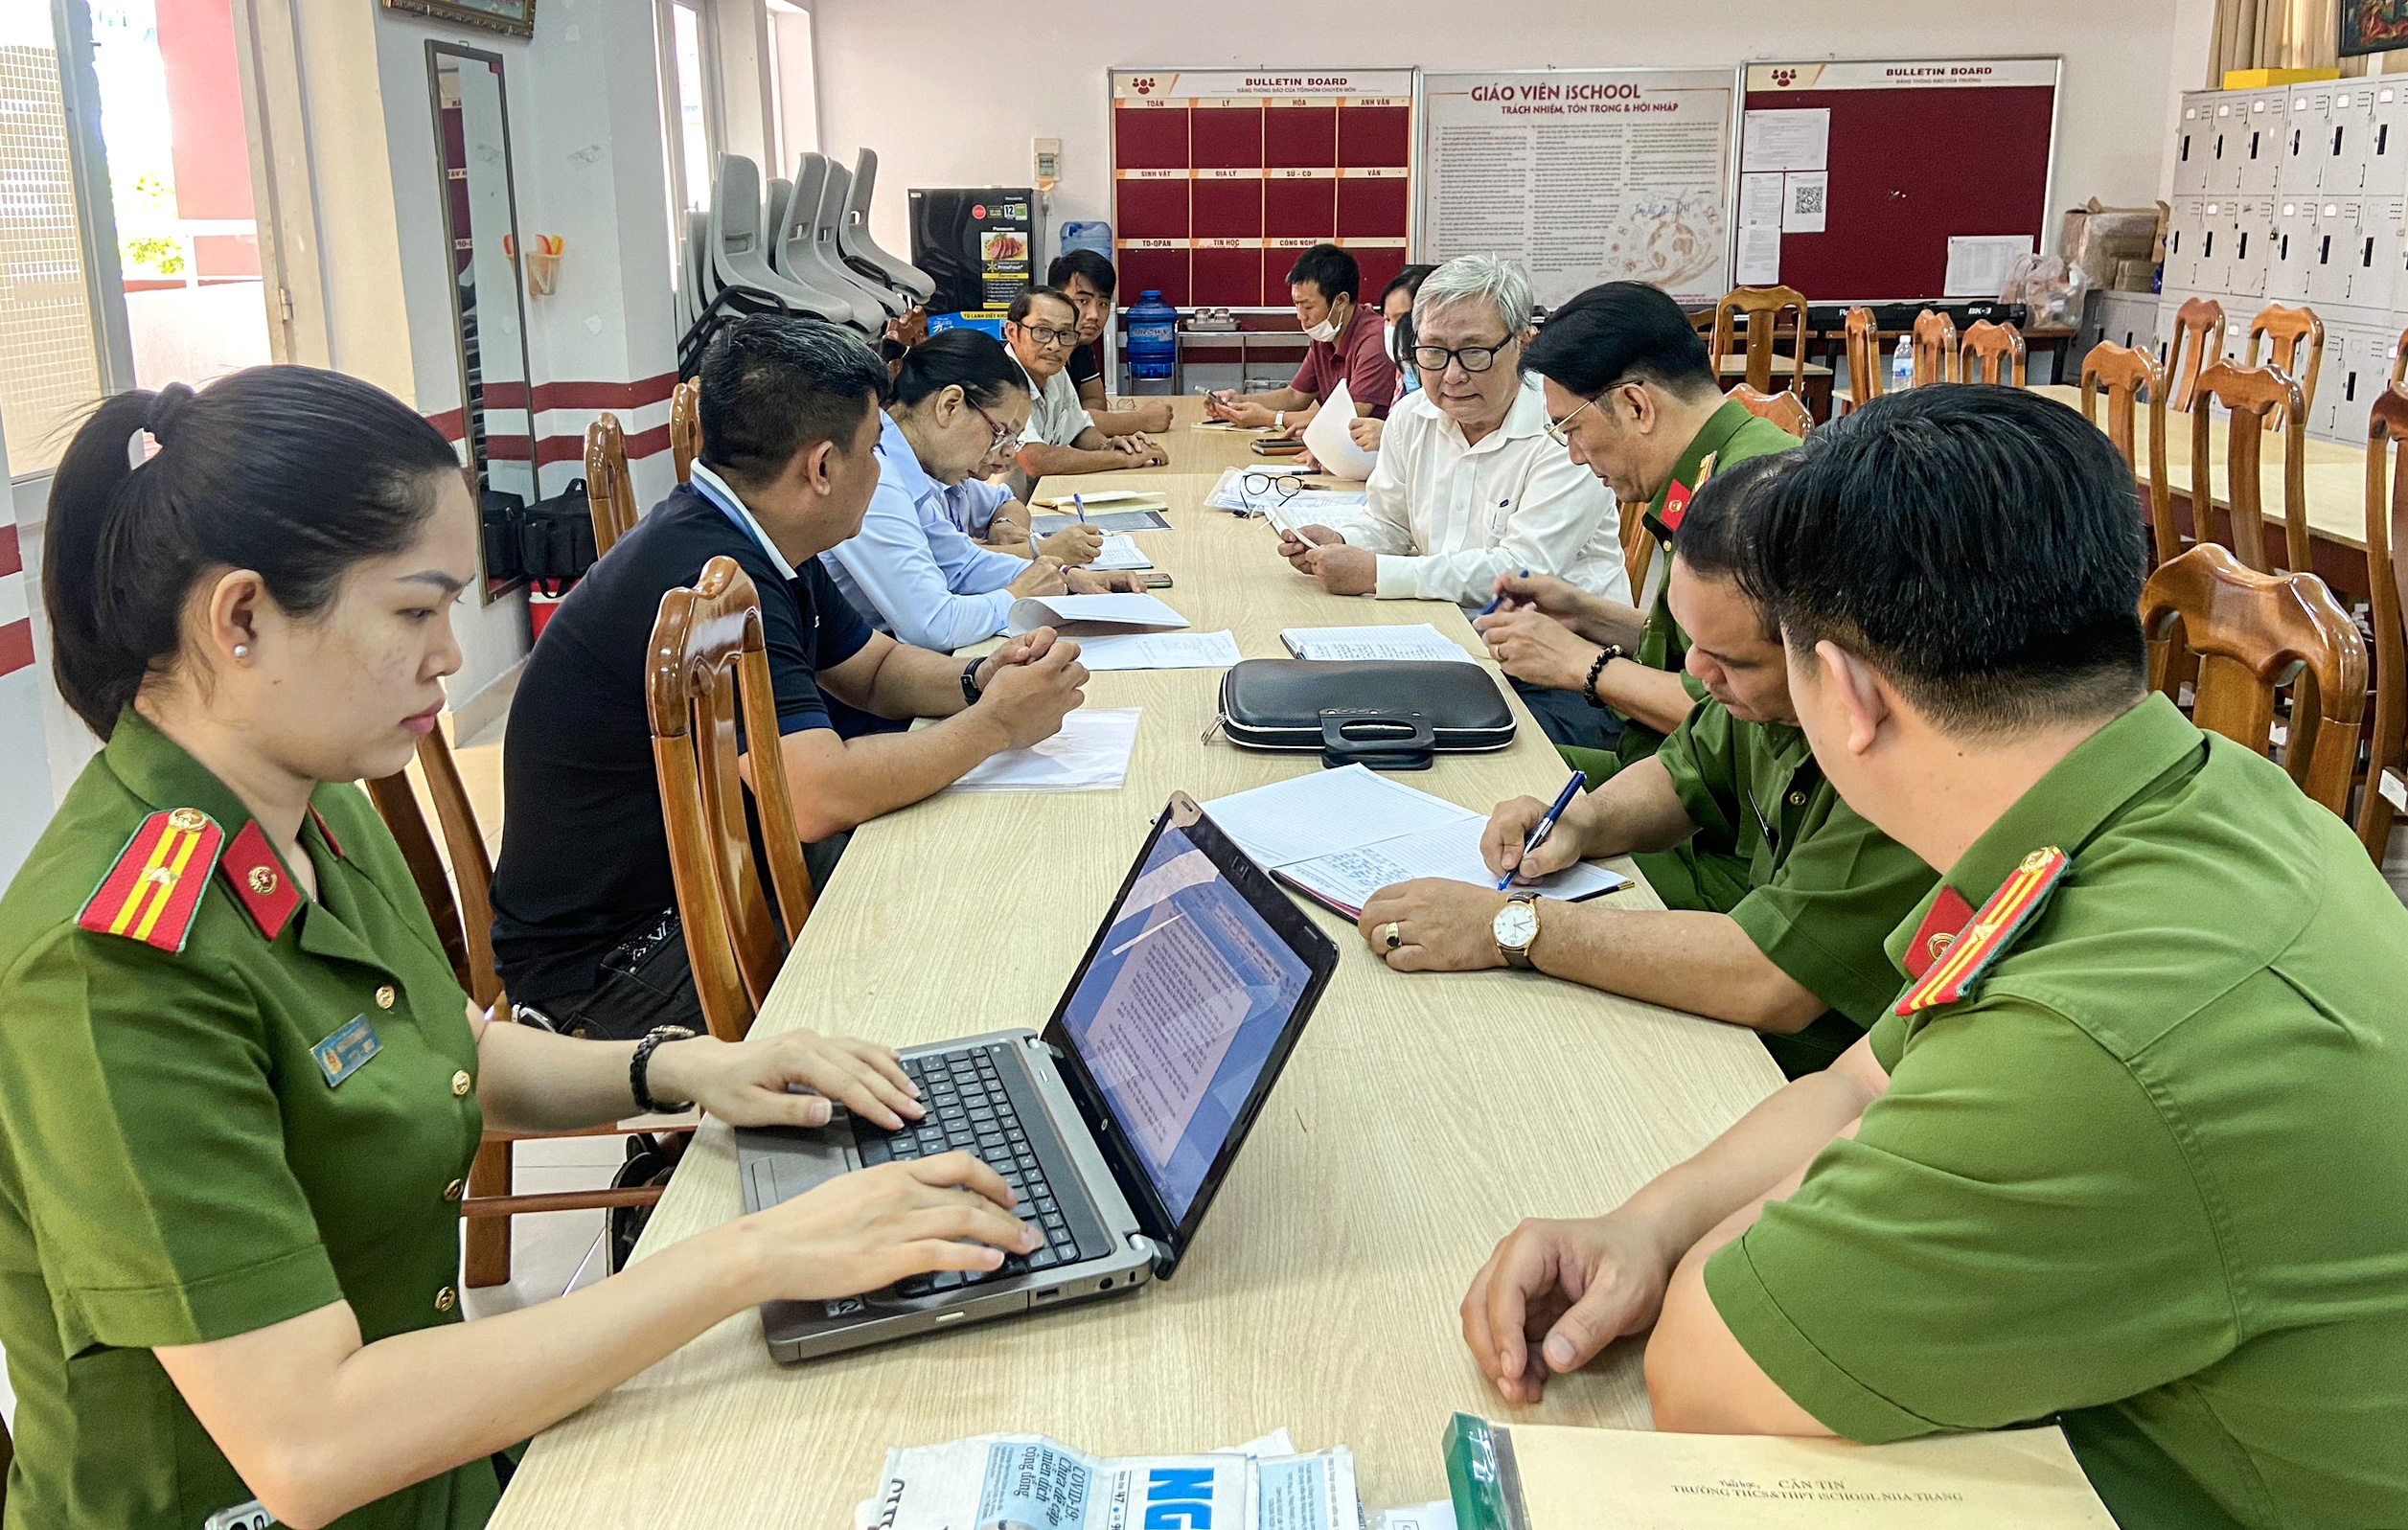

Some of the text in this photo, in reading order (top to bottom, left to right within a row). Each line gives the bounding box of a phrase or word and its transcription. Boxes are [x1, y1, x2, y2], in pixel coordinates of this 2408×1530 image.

[1246, 78, 1347, 86] BULLETIN BOARD
[1471, 82, 1640, 102] GIÁO VIÊN iSCHOOL
[1146, 99, 1164, 107] TOÁN
[1502, 103, 1530, 114] TRÁCH
[1568, 103, 1587, 113] TÔN
[1624, 103, 1630, 113] &
[1005, 205, 1014, 216] 12
[1019, 1446, 1040, 1471] cộng
[1055, 1457, 1072, 1488] Chưa
[1816, 1480, 1845, 1490] TIN
[1065, 1466, 1086, 1521] COVID-19:
[1882, 1492, 1913, 1501] NHA
[1915, 1492, 1963, 1501] TRANG
